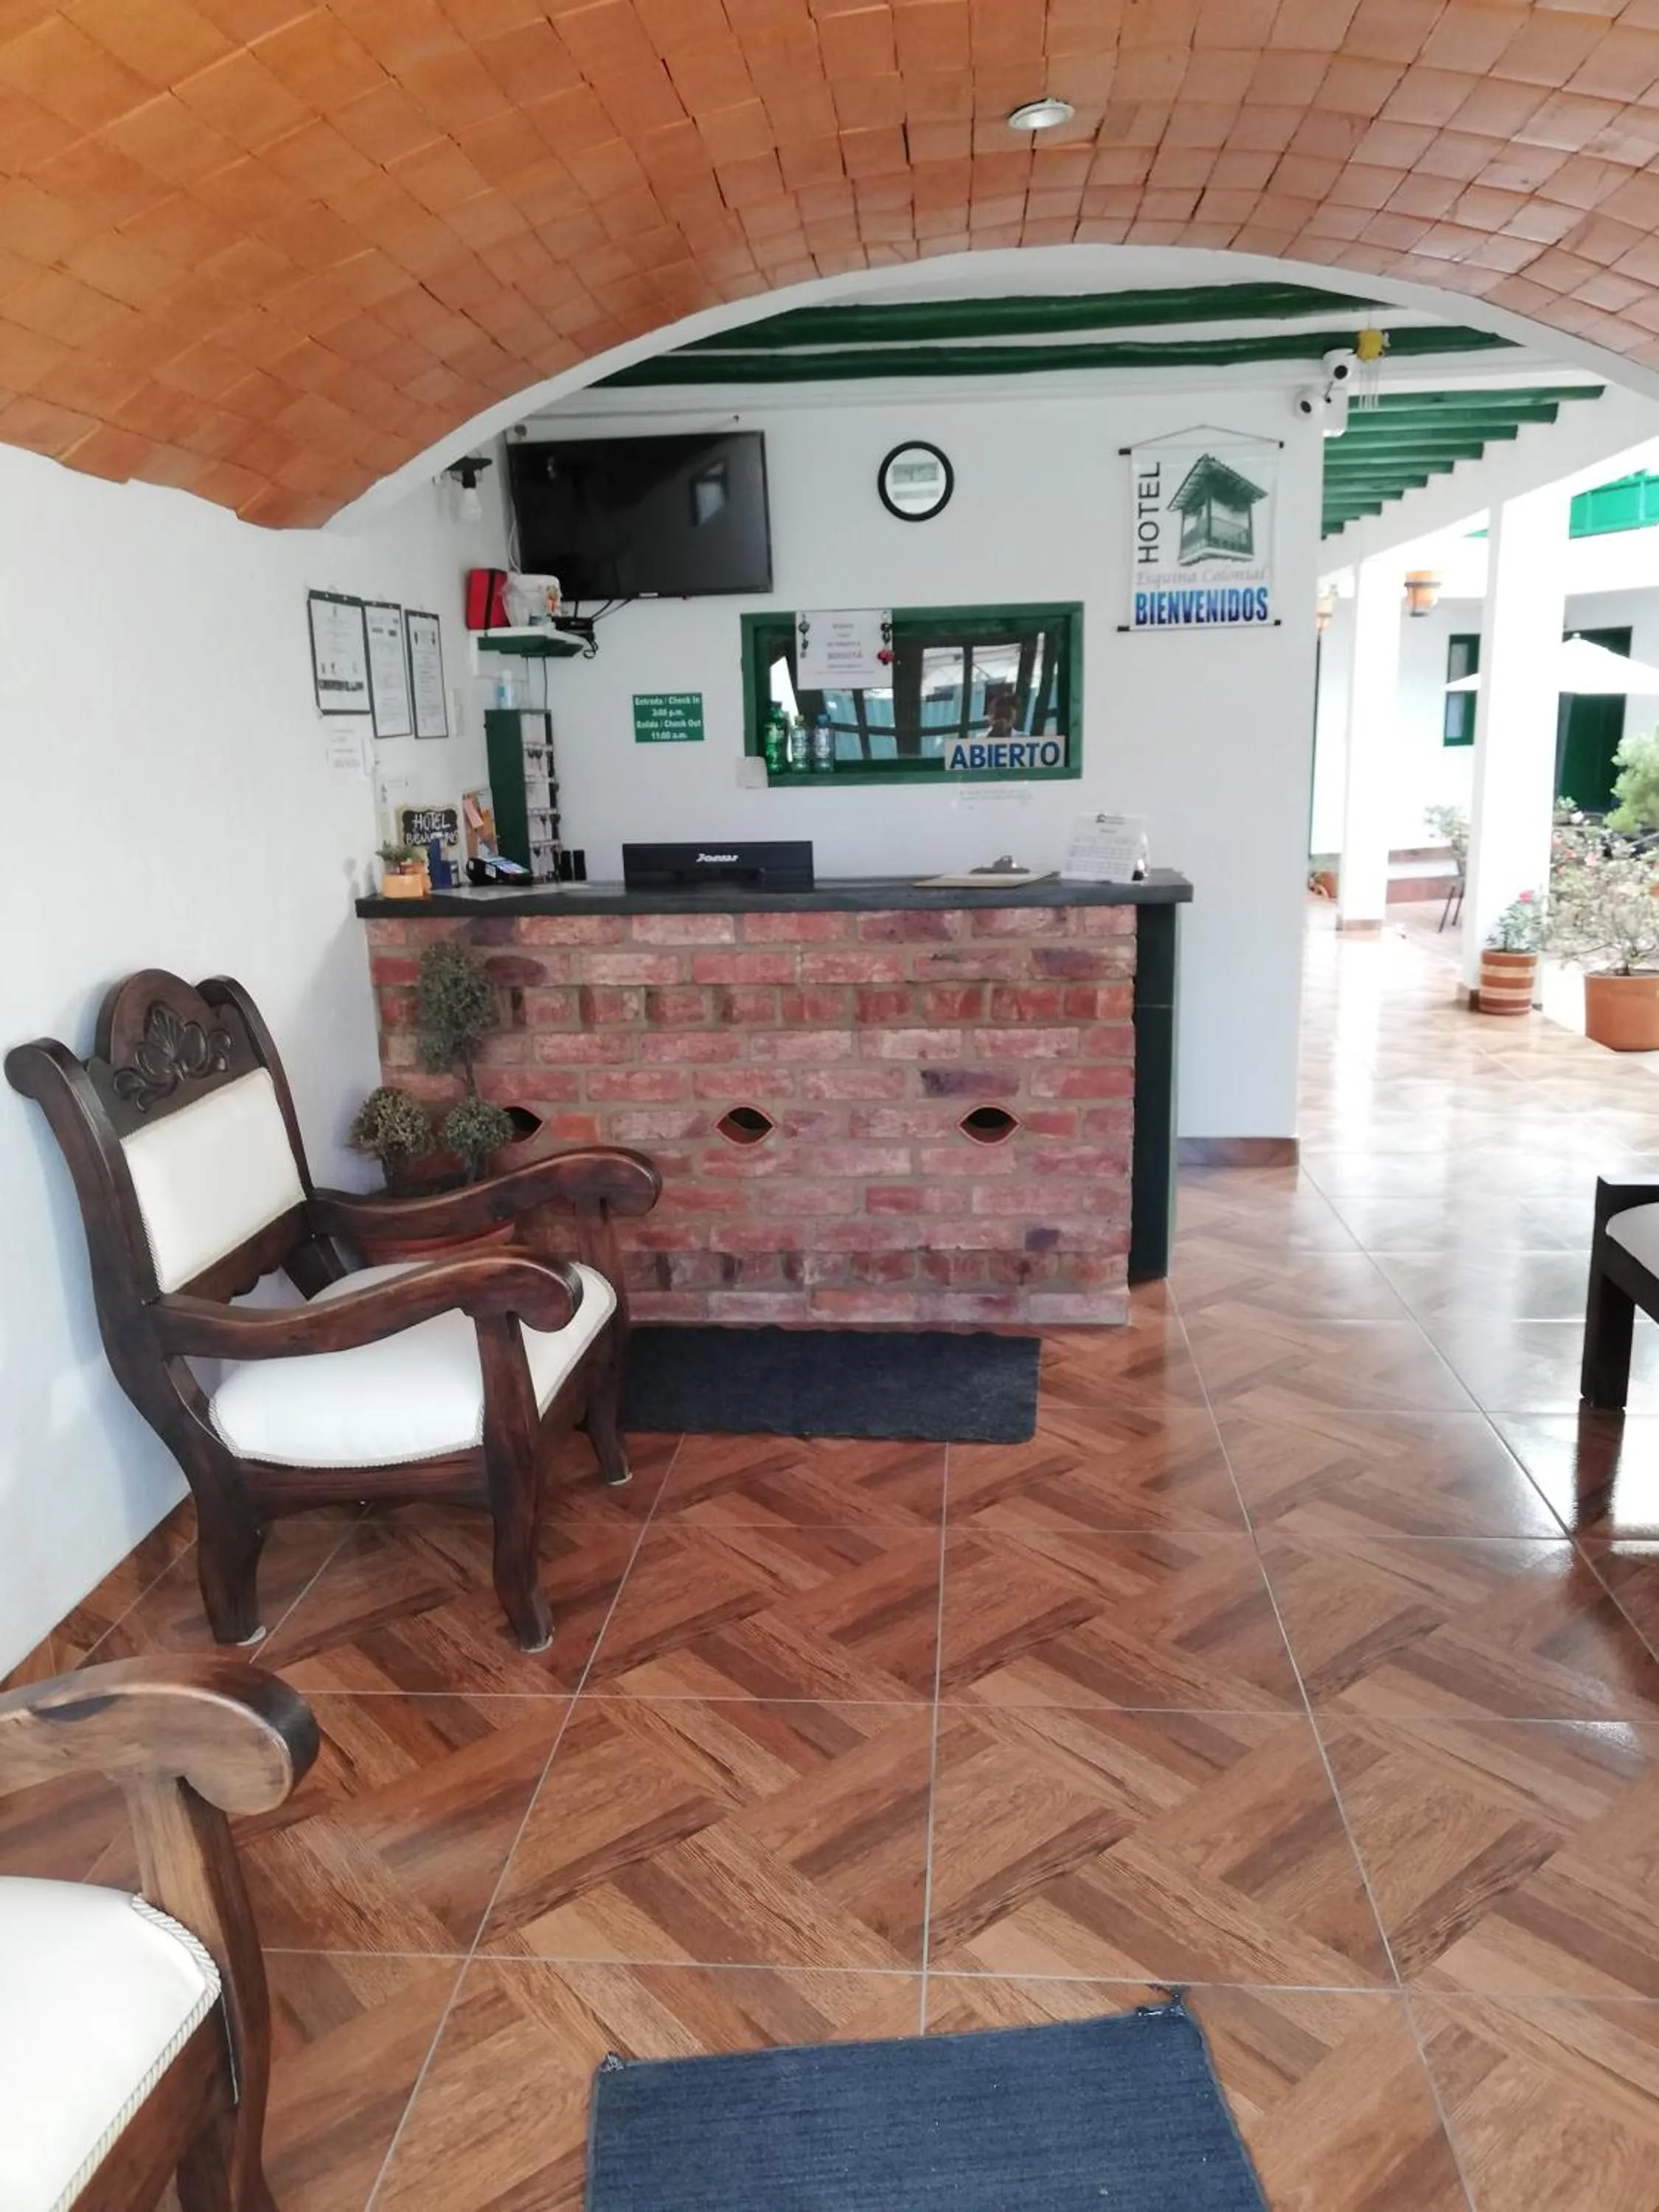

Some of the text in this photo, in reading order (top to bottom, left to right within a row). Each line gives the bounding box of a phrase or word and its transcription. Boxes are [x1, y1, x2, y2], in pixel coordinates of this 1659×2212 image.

[1138, 462, 1160, 563] HOTEL
[1203, 567, 1265, 582] Colonial
[1135, 587, 1268, 625] BIENVENIDOS
[636, 697, 663, 706] Entrada
[669, 696, 691, 704] Check
[664, 720, 686, 728] Check
[688, 719, 701, 727] Out
[950, 741, 1060, 769] ABIERTO
[412, 812, 451, 832] HOTEL
